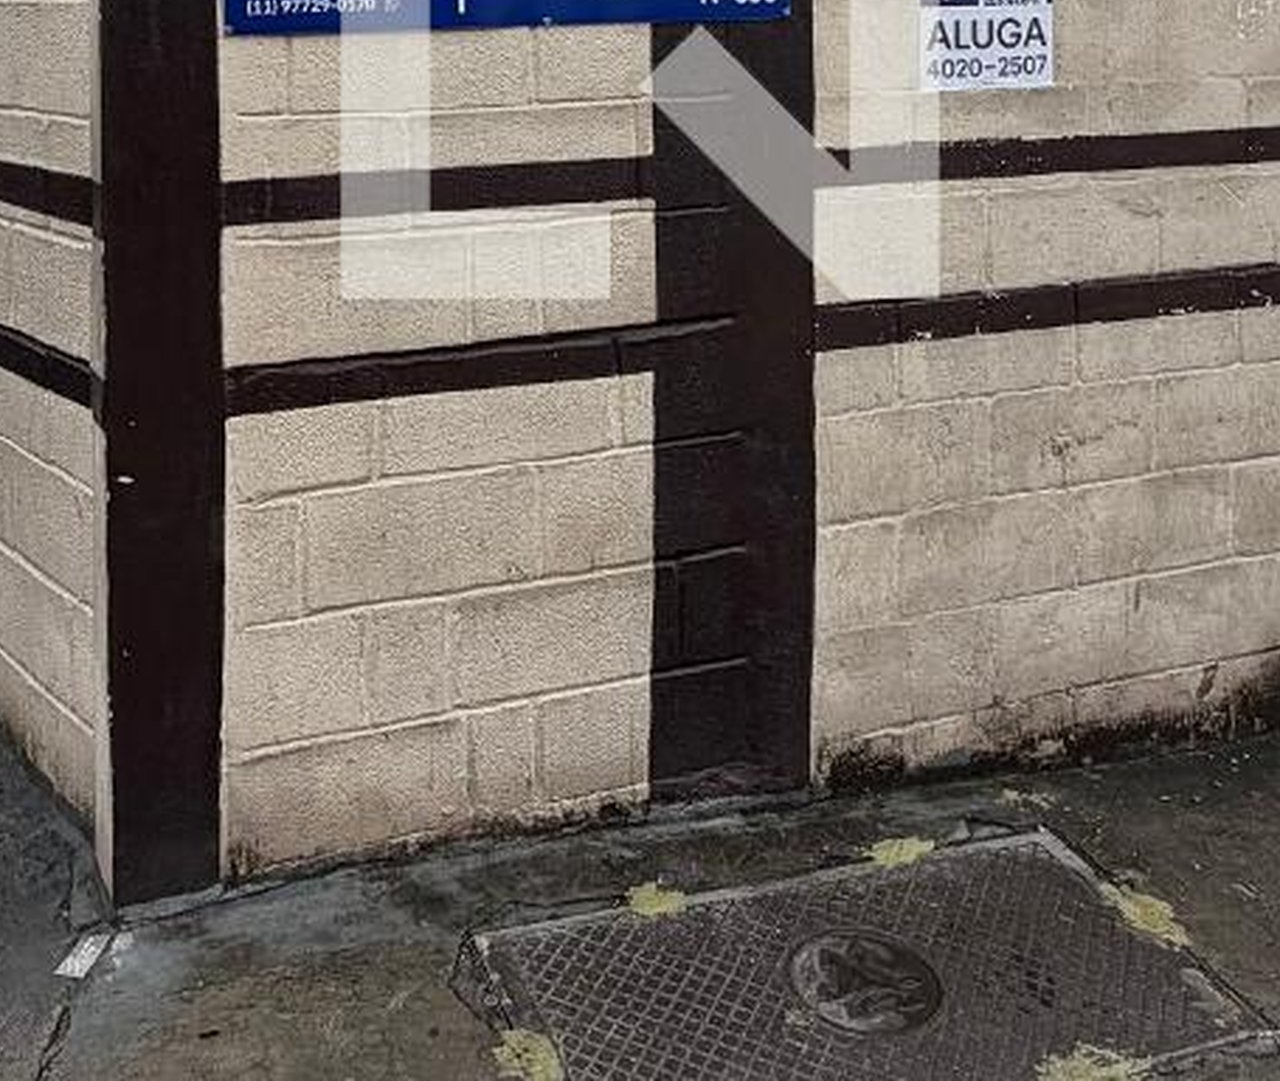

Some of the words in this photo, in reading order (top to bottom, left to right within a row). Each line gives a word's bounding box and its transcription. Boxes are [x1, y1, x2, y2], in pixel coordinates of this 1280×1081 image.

[246, 0, 277, 16] (11)
[927, 17, 1047, 52] ALUGA
[927, 55, 1048, 79] 4020-2507
